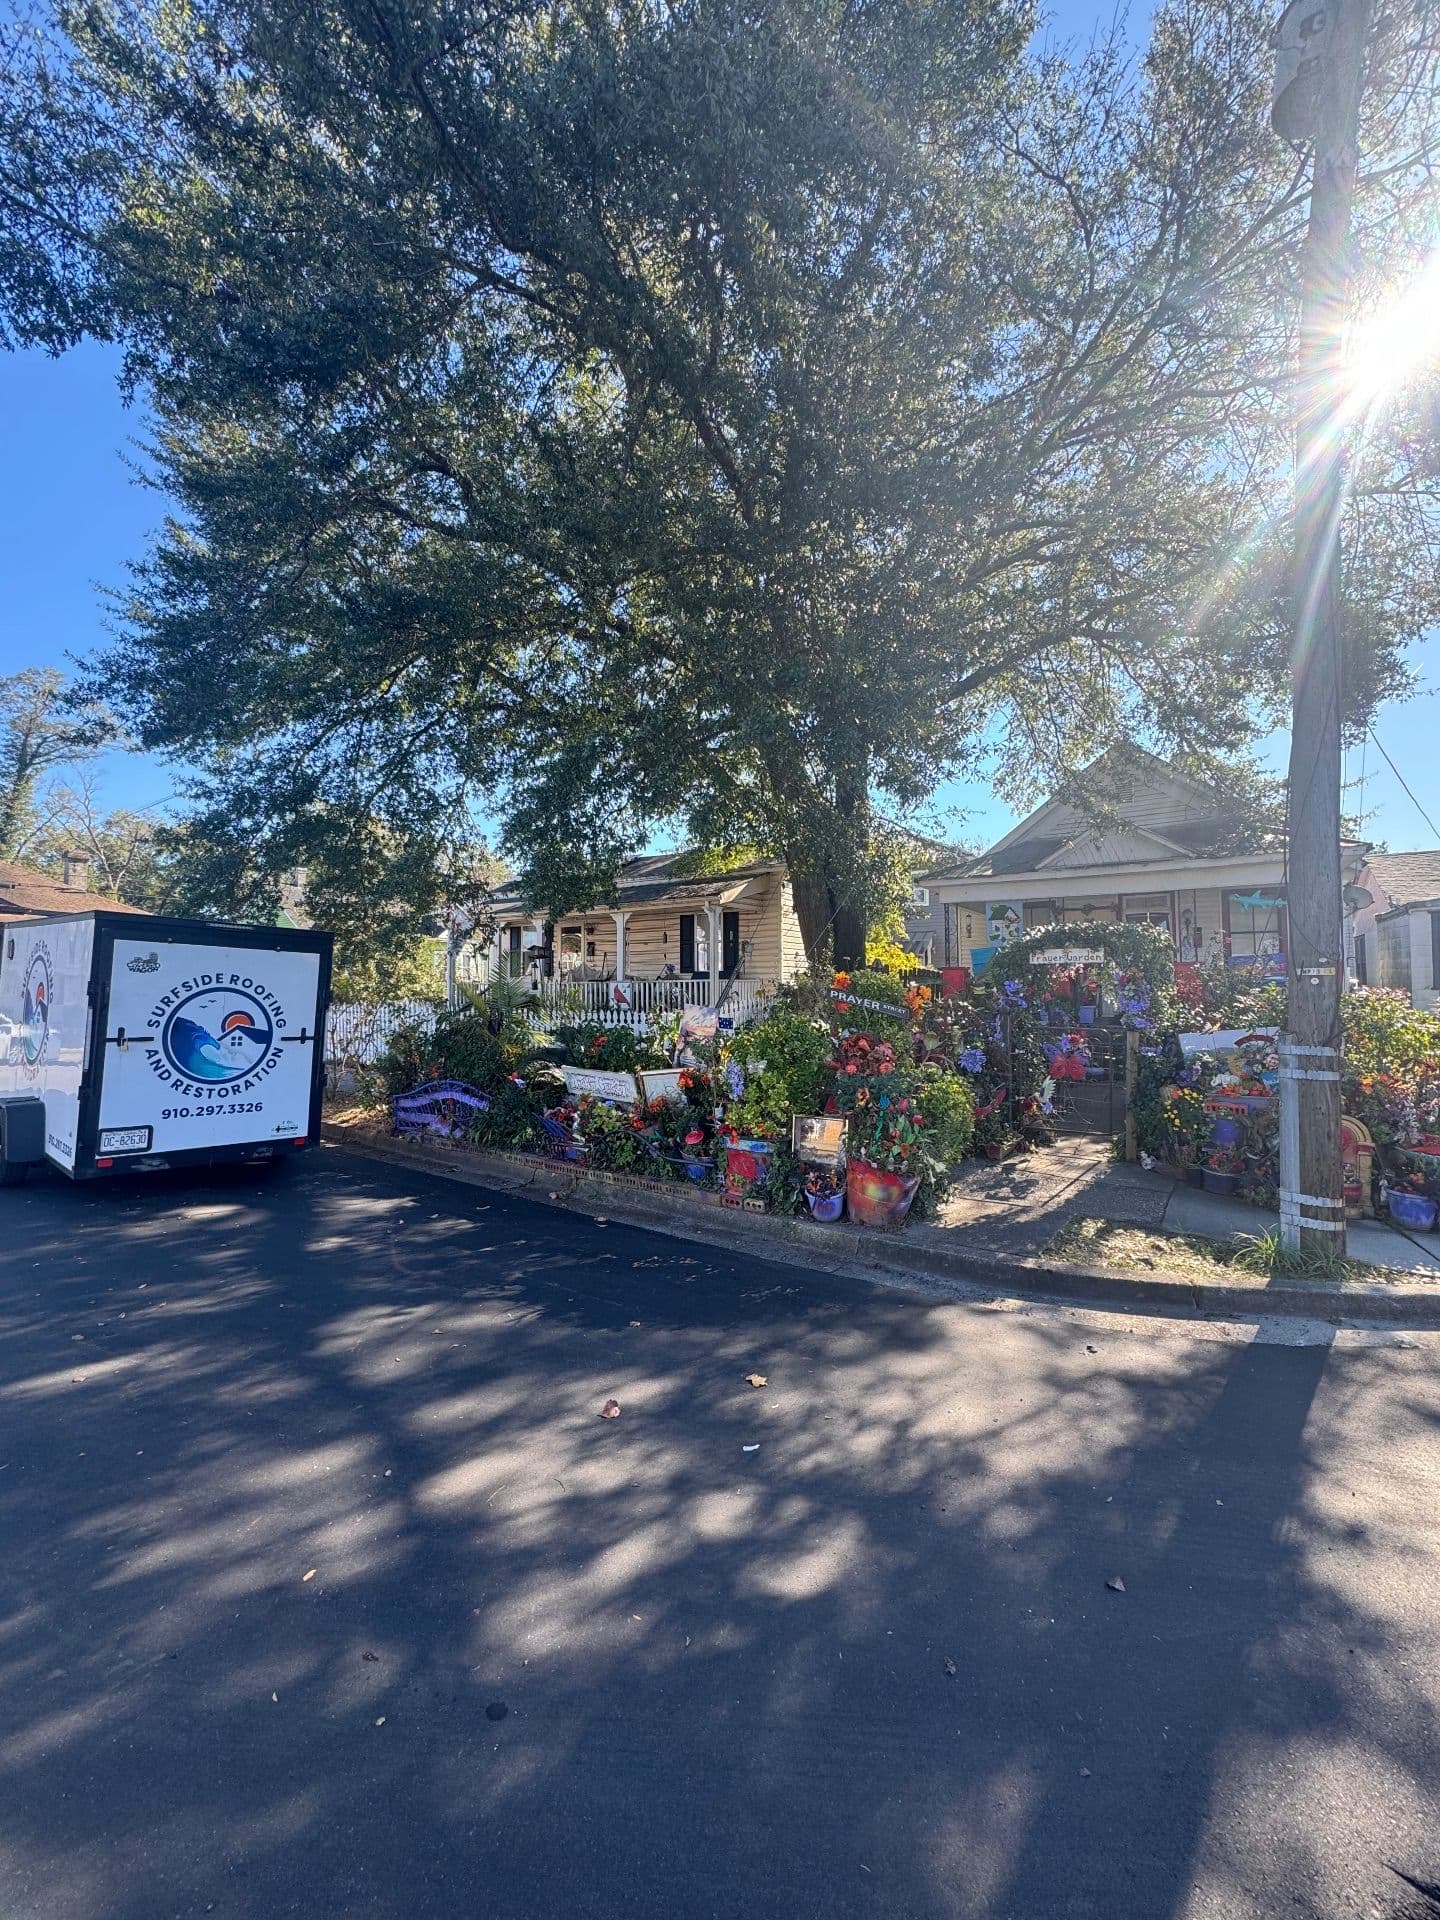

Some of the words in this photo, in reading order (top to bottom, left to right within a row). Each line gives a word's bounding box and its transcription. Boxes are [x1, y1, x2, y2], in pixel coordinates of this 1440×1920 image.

[147, 973, 224, 1029] SURFSIDE
[229, 974, 286, 1029] ROOFING
[830, 990, 880, 1010] PRAYER
[882, 1004, 906, 1014] STREET
[145, 1048, 172, 1081] AND
[170, 1047, 284, 1099] RESTORATION
[161, 1102, 263, 1119] 910.297.3326
